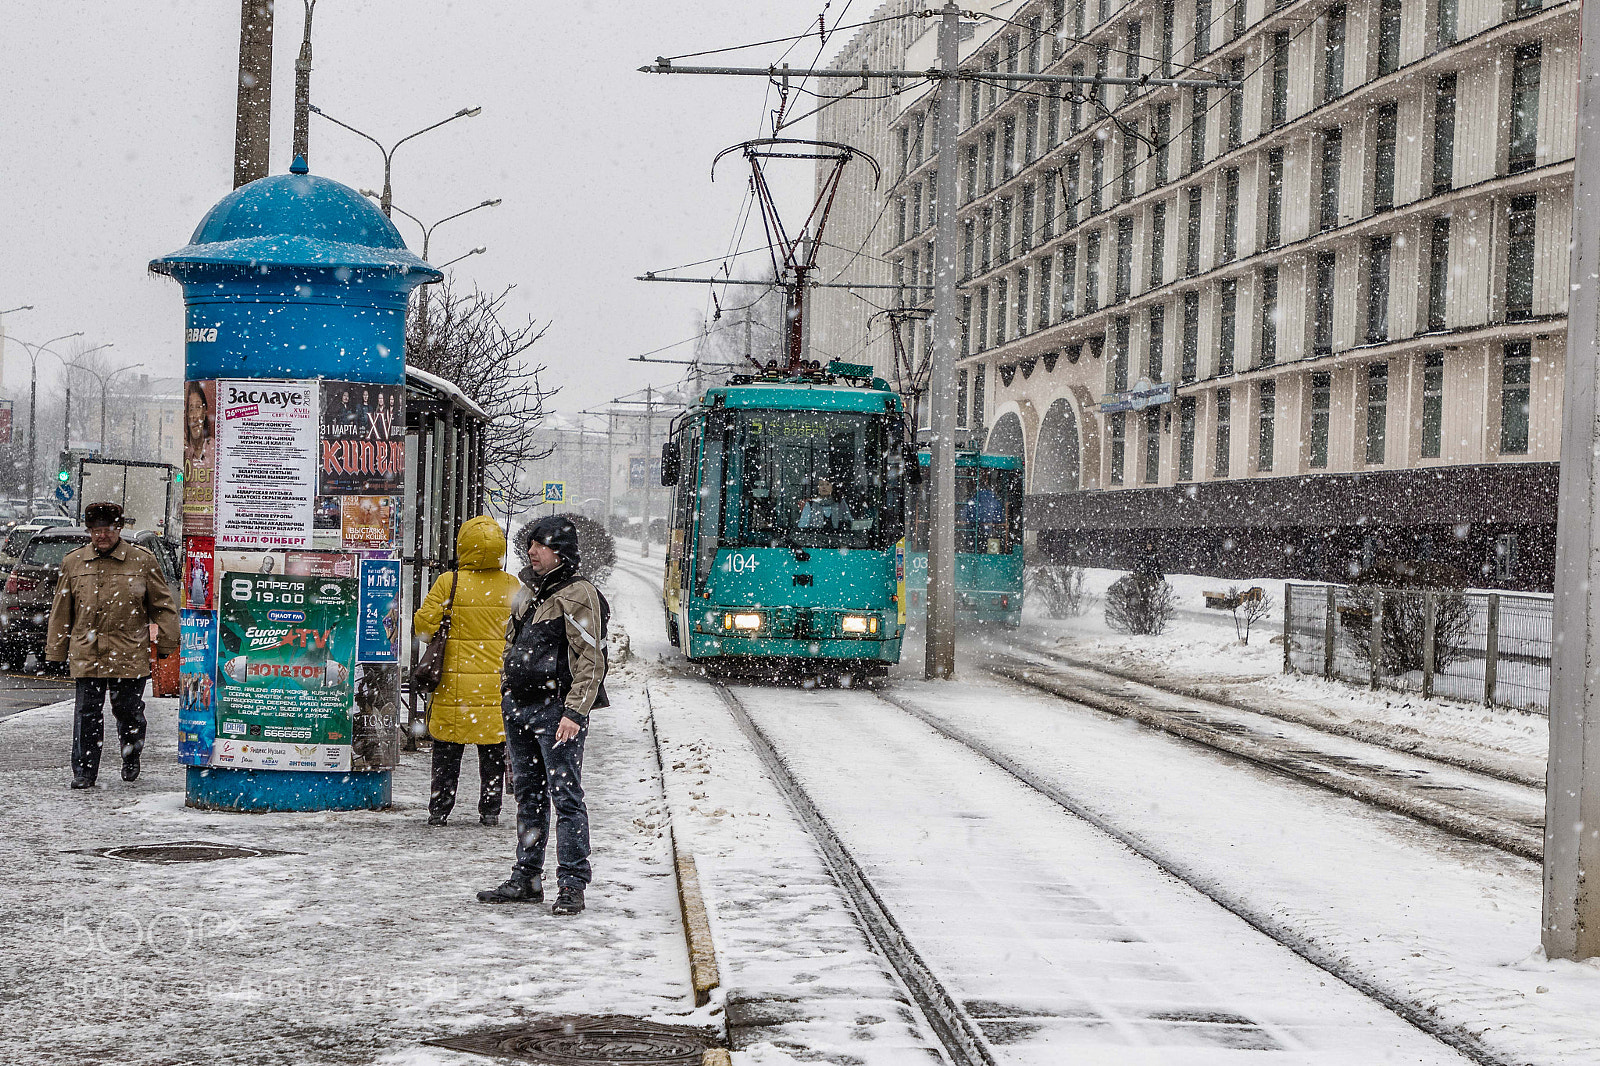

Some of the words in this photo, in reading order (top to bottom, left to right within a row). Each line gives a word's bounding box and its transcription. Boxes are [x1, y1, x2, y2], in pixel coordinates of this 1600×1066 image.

[332, 424, 358, 435] МАРТА
[185, 458, 215, 483] Олег
[260, 536, 306, 545] ФІНБЕРГ
[990, 541, 999, 553] 3
[726, 553, 756, 573] 104
[231, 578, 253, 601] 8
[256, 580, 305, 591] АПРЕЛЯ
[255, 592, 304, 604] 19:00
[195, 618, 210, 628] ТУР
[245, 626, 289, 638] Europa
[295, 628, 331, 649] TV
[327, 732, 343, 740] 12+
